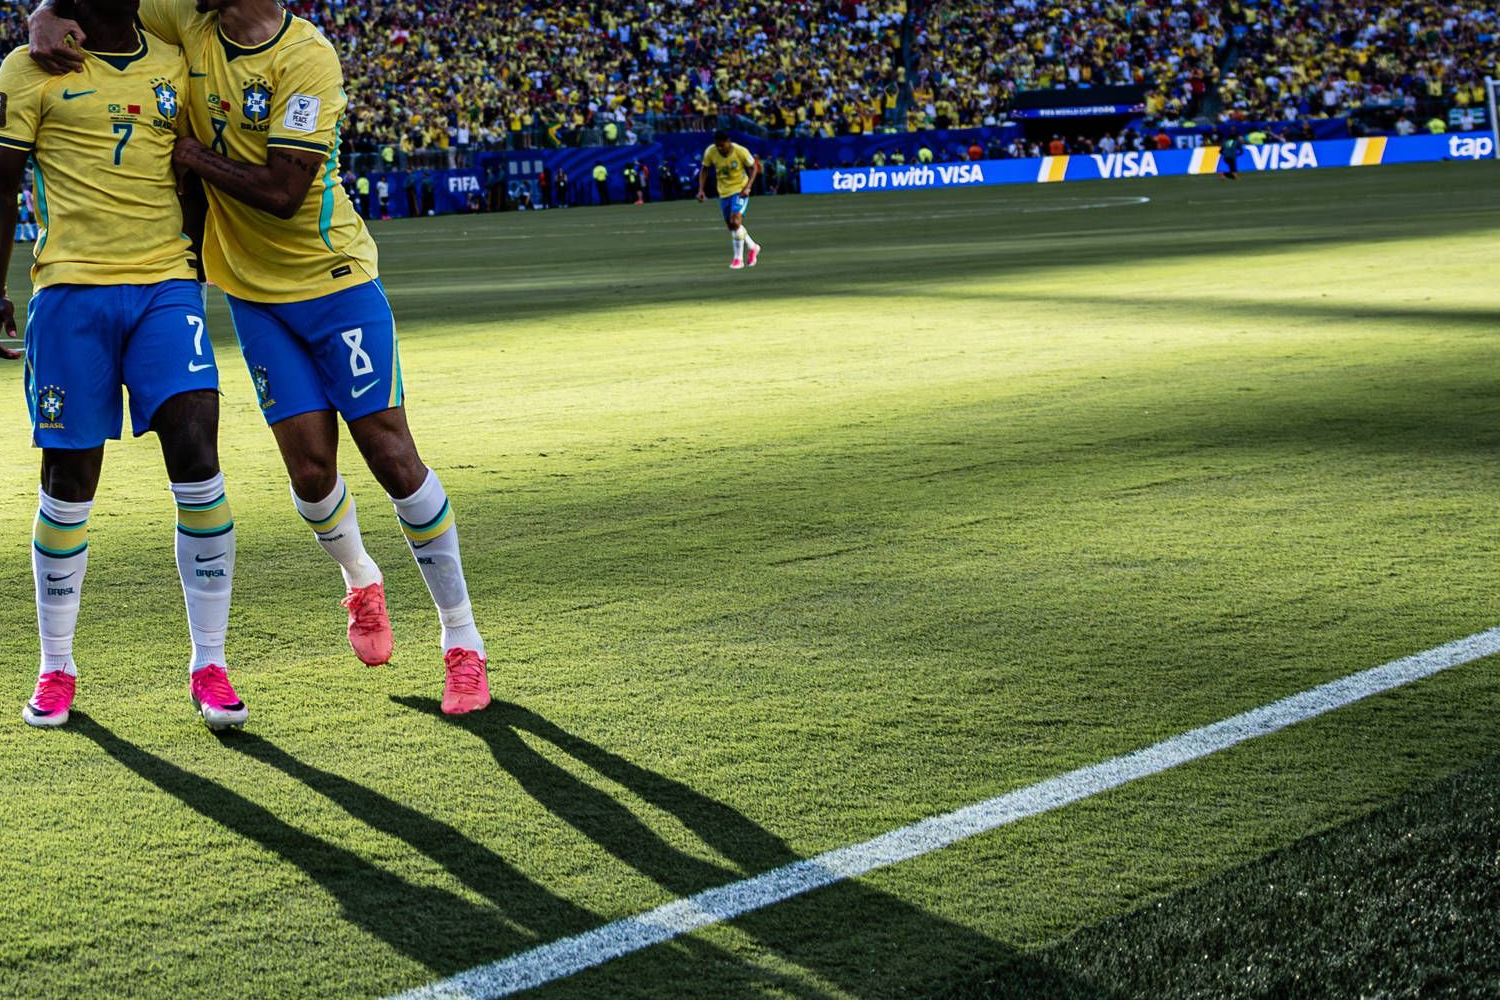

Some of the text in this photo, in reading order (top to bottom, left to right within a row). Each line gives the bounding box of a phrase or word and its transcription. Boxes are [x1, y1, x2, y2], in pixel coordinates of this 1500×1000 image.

[292, 115, 308, 124] PEACE
[113, 124, 133, 165] 7
[1176, 135, 1204, 148] FIF
[1449, 135, 1493, 160] tap
[1090, 151, 1158, 179] VISA
[1244, 142, 1317, 170] VISA
[448, 176, 480, 193] FIFA
[833, 164, 984, 192] tap in with VISA
[186, 315, 204, 356] 7
[341, 328, 373, 377] 8
[196, 569, 227, 577] BRASIL
[47, 587, 75, 596] BRASIL
